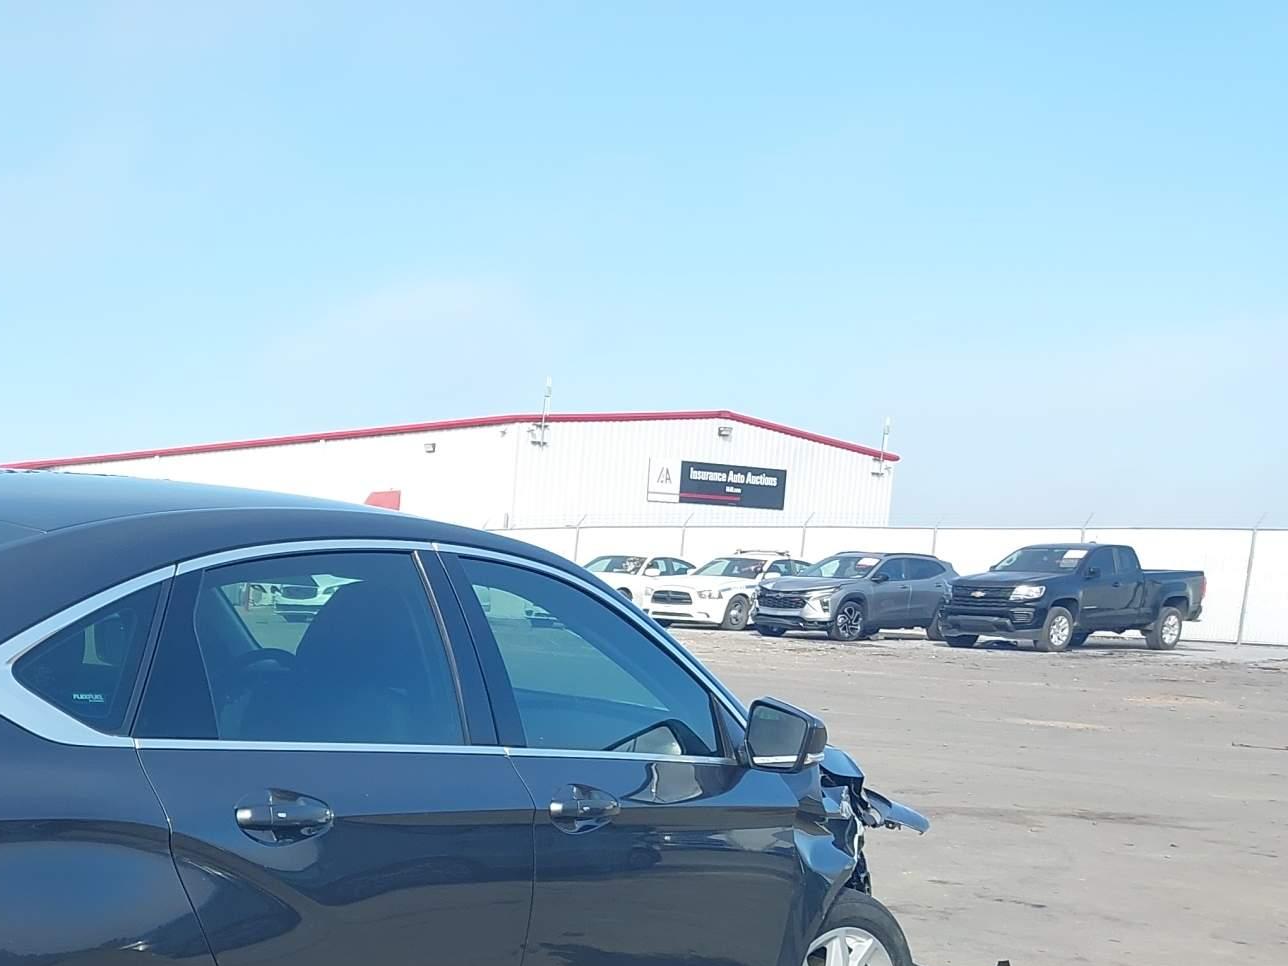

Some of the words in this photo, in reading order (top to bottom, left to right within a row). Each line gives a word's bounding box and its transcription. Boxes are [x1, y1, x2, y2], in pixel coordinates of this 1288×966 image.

[689, 467, 727, 483] Insurance
[728, 470, 745, 485] Auto
[746, 472, 778, 487] Auctions
